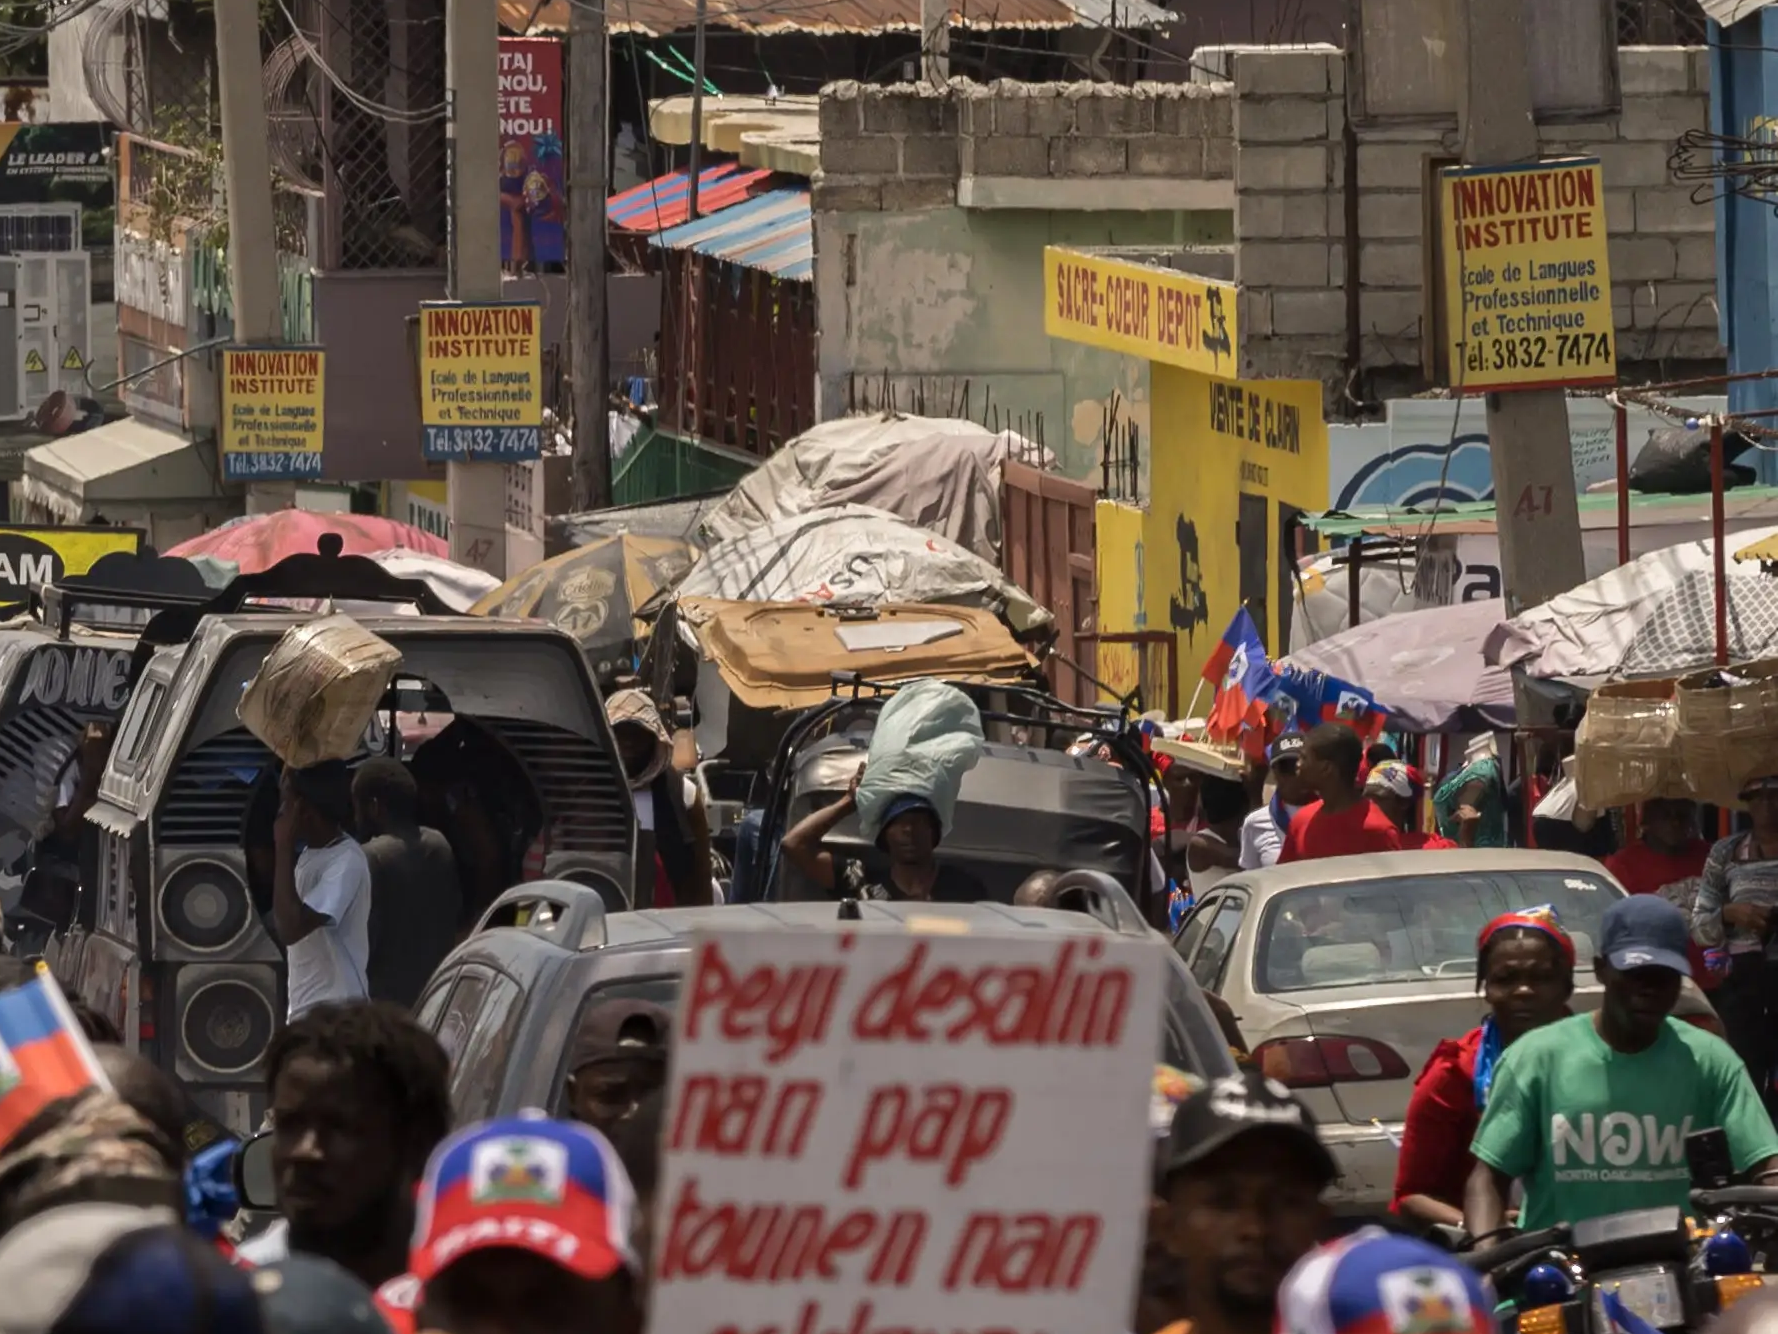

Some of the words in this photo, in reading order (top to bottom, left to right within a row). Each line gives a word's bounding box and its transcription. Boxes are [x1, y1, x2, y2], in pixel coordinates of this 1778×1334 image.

[498, 52, 533, 73] TAJ
[498, 75, 548, 94] NOU,
[7, 152, 26, 166] LE
[29, 151, 86, 165] LEADER
[1452, 167, 1596, 221] INNOVATION
[1455, 212, 1593, 251] INSTITUTE
[1501, 261, 1522, 283] de
[1529, 258, 1596, 284] Langues
[1057, 262, 1150, 342] SACRE-COEUR
[1157, 285, 1203, 352] DEPOT
[1464, 280, 1601, 313] Professionnelle
[427, 307, 534, 338] INNOVATION
[1471, 316, 1490, 337] et
[1495, 310, 1586, 336] Technique
[427, 338, 532, 359] INSTITUTE
[1492, 331, 1611, 371] 3832-7474
[229, 352, 319, 377] INNOVATION
[463, 368, 478, 385] de
[481, 368, 531, 387] Langues
[230, 378, 316, 395] INSTITUTE
[431, 386, 533, 403] Professionnelle
[259, 403, 271, 417] de
[275, 403, 316, 418] Langues
[438, 406, 453, 421] et
[456, 405, 522, 422] Technique
[1209, 381, 1245, 439] VENTE
[1248, 391, 1262, 444] DE
[232, 418, 318, 433] Professionnelle
[684, 931, 856, 1065] Peyi
[850, 937, 1134, 1048] desalin
[666, 1072, 826, 1161] nan
[841, 1083, 1015, 1191] pap
[1551, 1111, 1694, 1166] NOW
[656, 1177, 929, 1291] tounen
[940, 1210, 1105, 1294] nan
